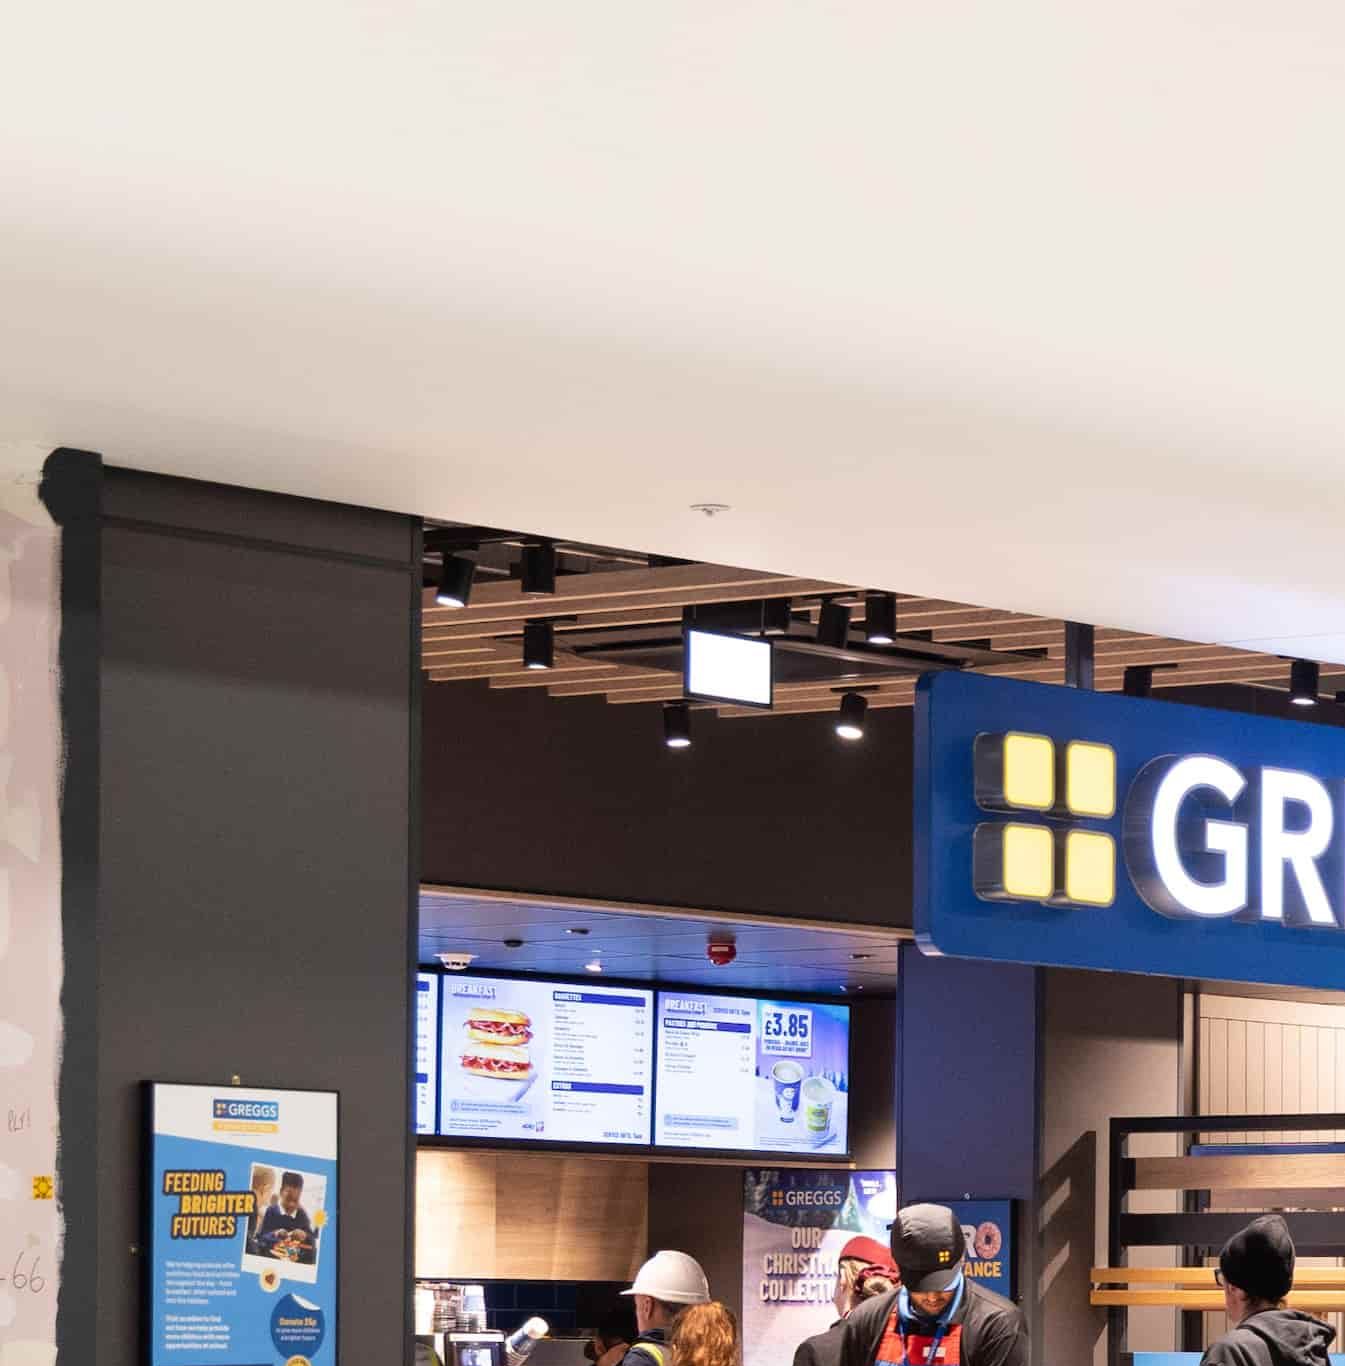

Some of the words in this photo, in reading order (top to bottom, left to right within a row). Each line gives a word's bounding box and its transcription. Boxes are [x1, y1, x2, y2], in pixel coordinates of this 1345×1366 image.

[765, 1012, 809, 1038] £3.85
[228, 1103, 277, 1118] GREGGS
[165, 1171, 225, 1193] FEEDING
[180, 1194, 255, 1214] BRIGHTER
[785, 1190, 842, 1206] GREGGS
[173, 1216, 236, 1237] FUTURES
[791, 1227, 821, 1248] OUR
[763, 1253, 839, 1275] CHRISTMA
[962, 1261, 1002, 1277] ANCE
[760, 1280, 834, 1301] COLLECTI
